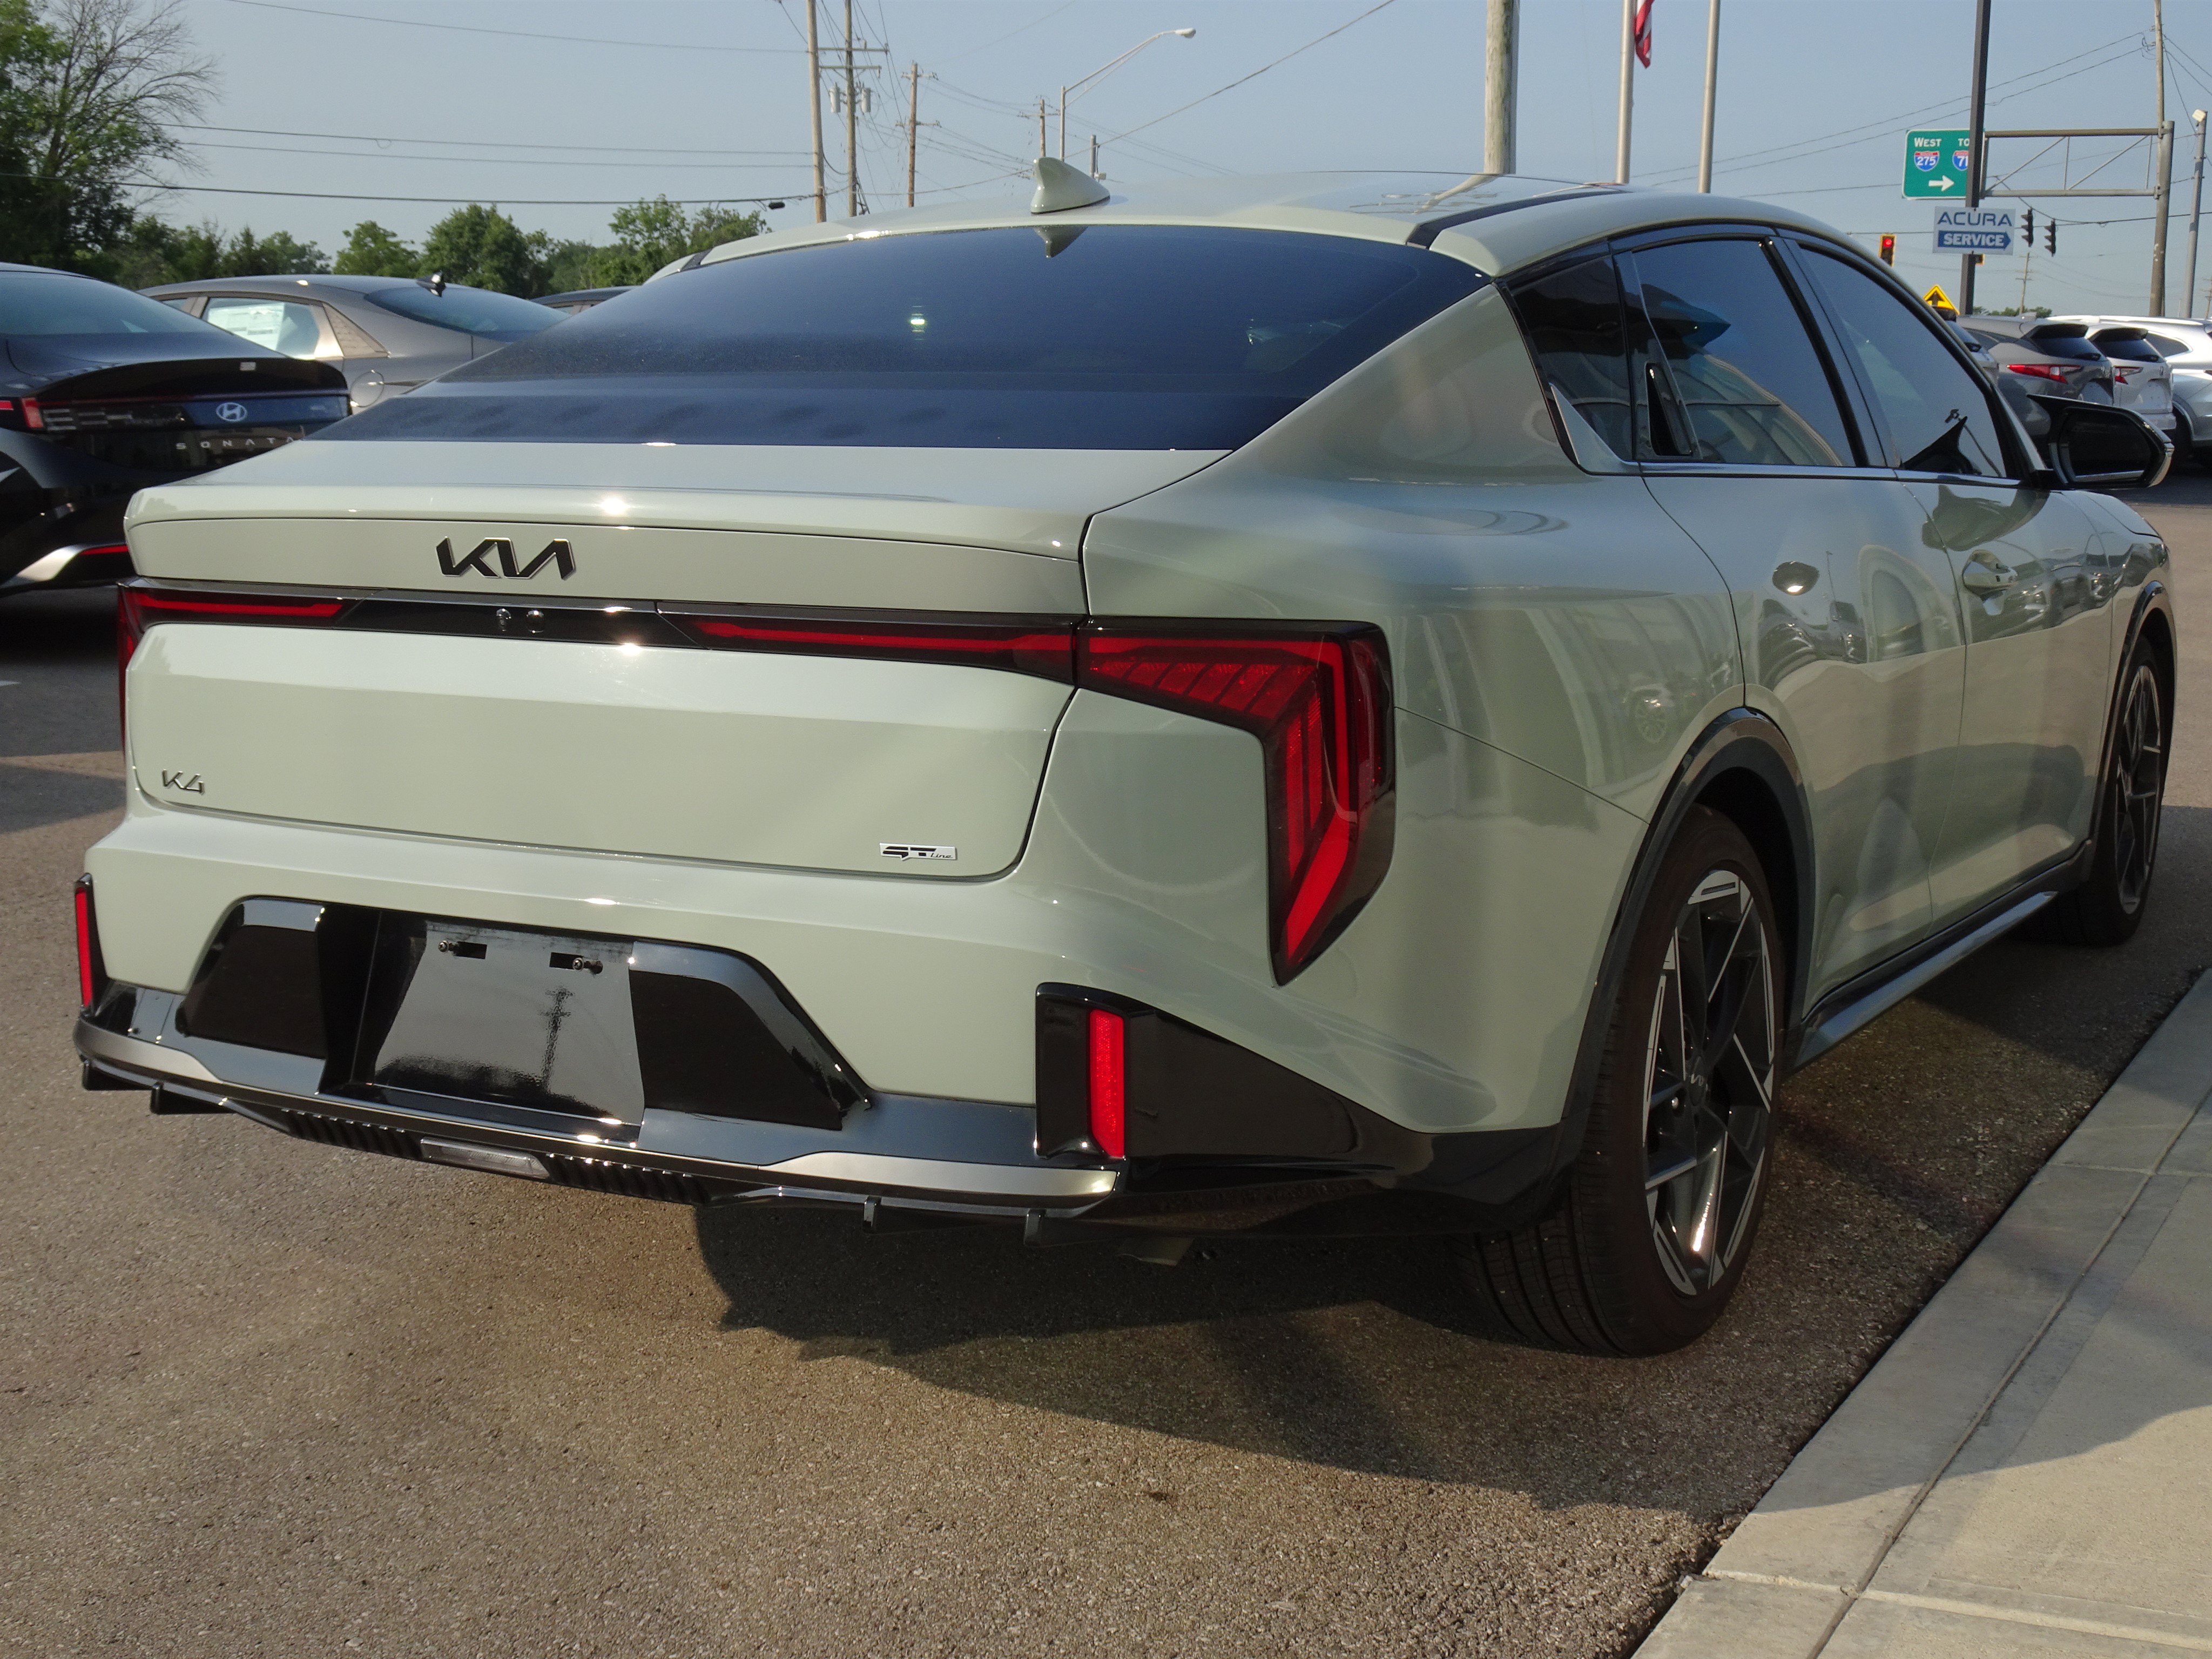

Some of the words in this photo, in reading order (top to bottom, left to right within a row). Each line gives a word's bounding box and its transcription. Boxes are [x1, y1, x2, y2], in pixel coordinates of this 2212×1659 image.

[1914, 137, 1942, 147] WEST
[1958, 138, 1970, 146] TO
[1917, 156, 1936, 166] 275
[1957, 156, 1968, 167] 71
[1937, 211, 2013, 227] ACURA
[1943, 232, 2005, 247] SERVICE
[176, 436, 294, 450] SONATA
[435, 536, 576, 581] KIA
[162, 769, 205, 795] K4
